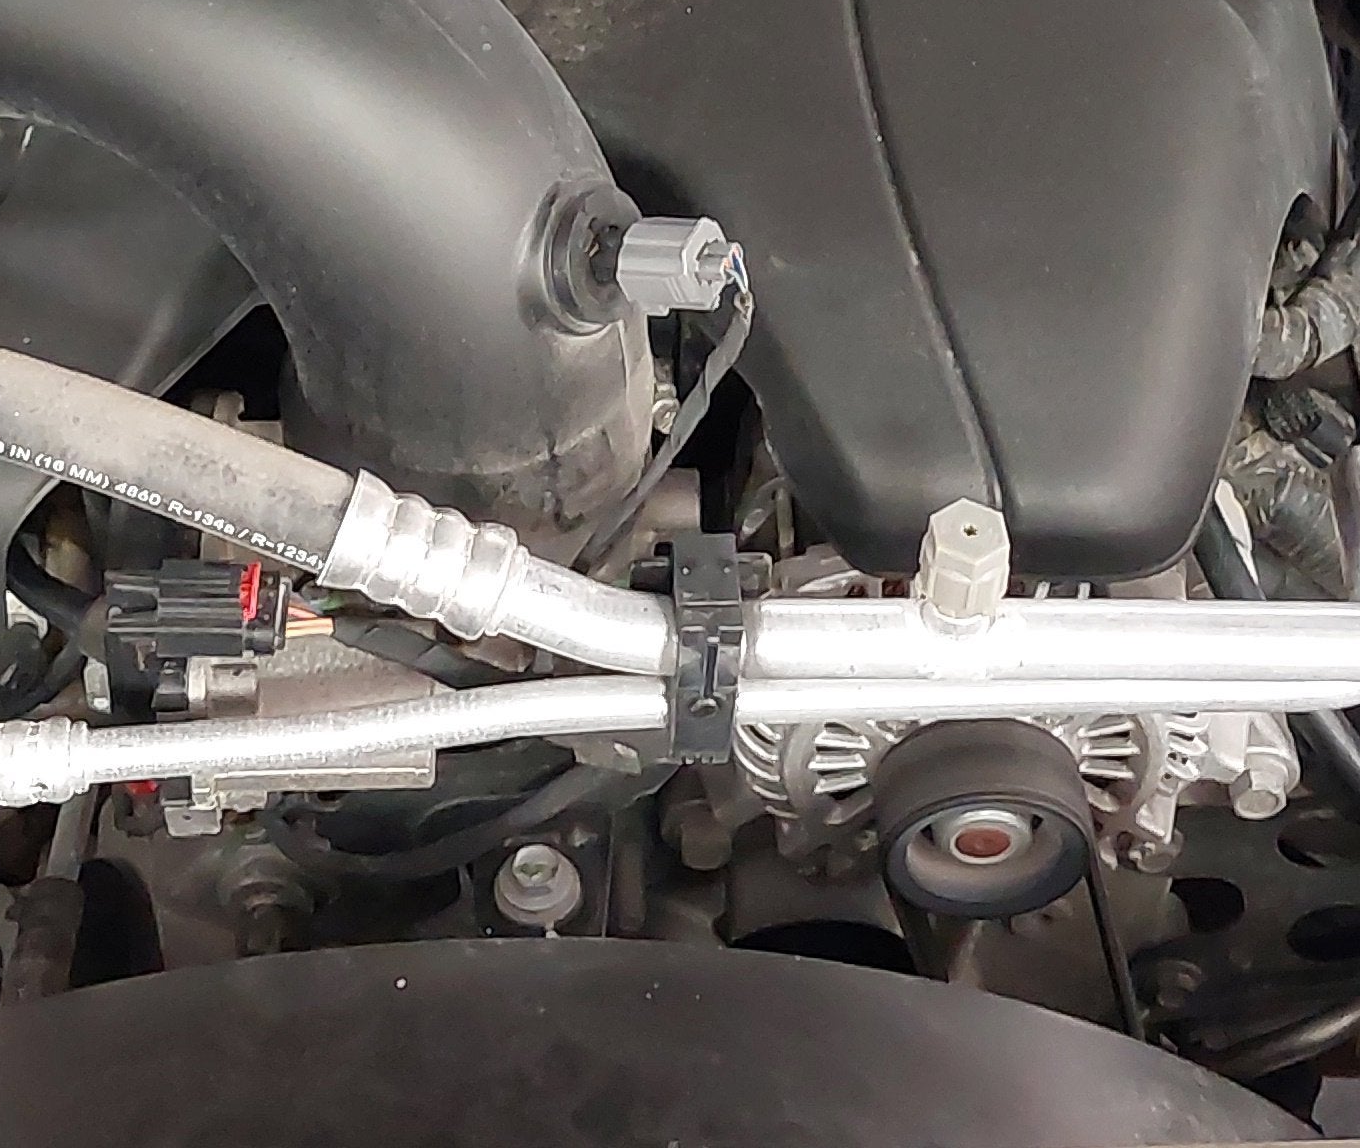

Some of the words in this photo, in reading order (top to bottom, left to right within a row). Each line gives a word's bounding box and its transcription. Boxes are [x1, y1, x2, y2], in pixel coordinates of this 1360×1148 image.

[9, 444, 31, 462] IN
[68, 463, 110, 490] MM)
[167, 499, 236, 536] R-134a
[250, 531, 326, 571] R-1234y
